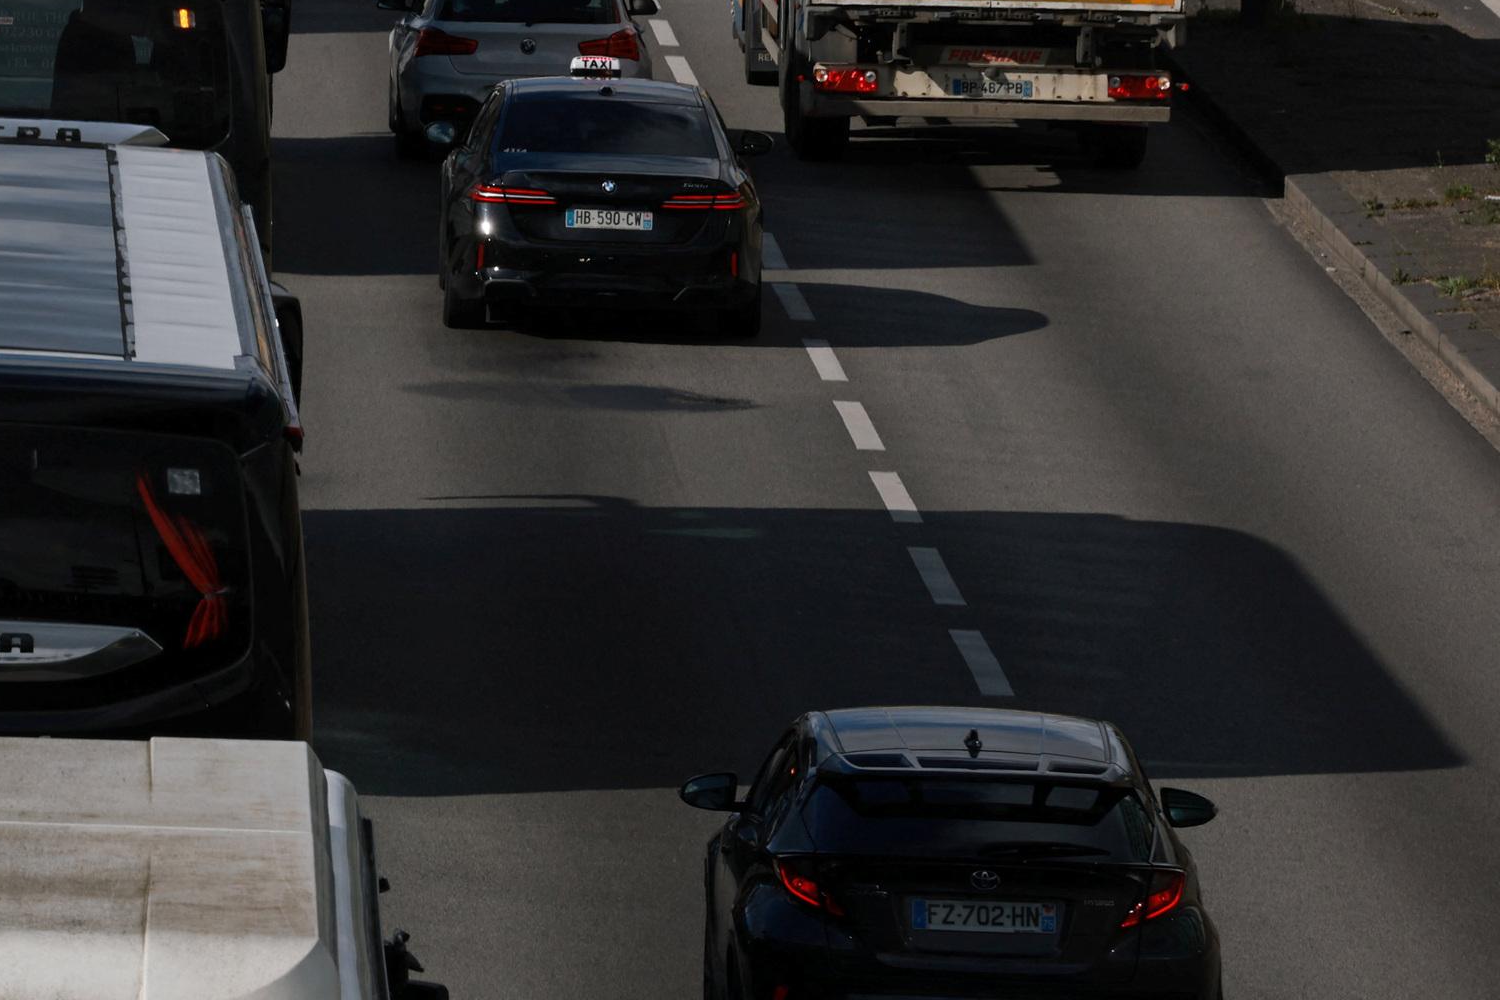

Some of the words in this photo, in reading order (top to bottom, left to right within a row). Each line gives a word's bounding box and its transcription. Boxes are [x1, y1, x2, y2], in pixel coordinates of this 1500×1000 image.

[583, 60, 612, 70] TAXI
[575, 209, 642, 226] HB-590-CW
[927, 904, 1040, 928] FZ-702-HN
